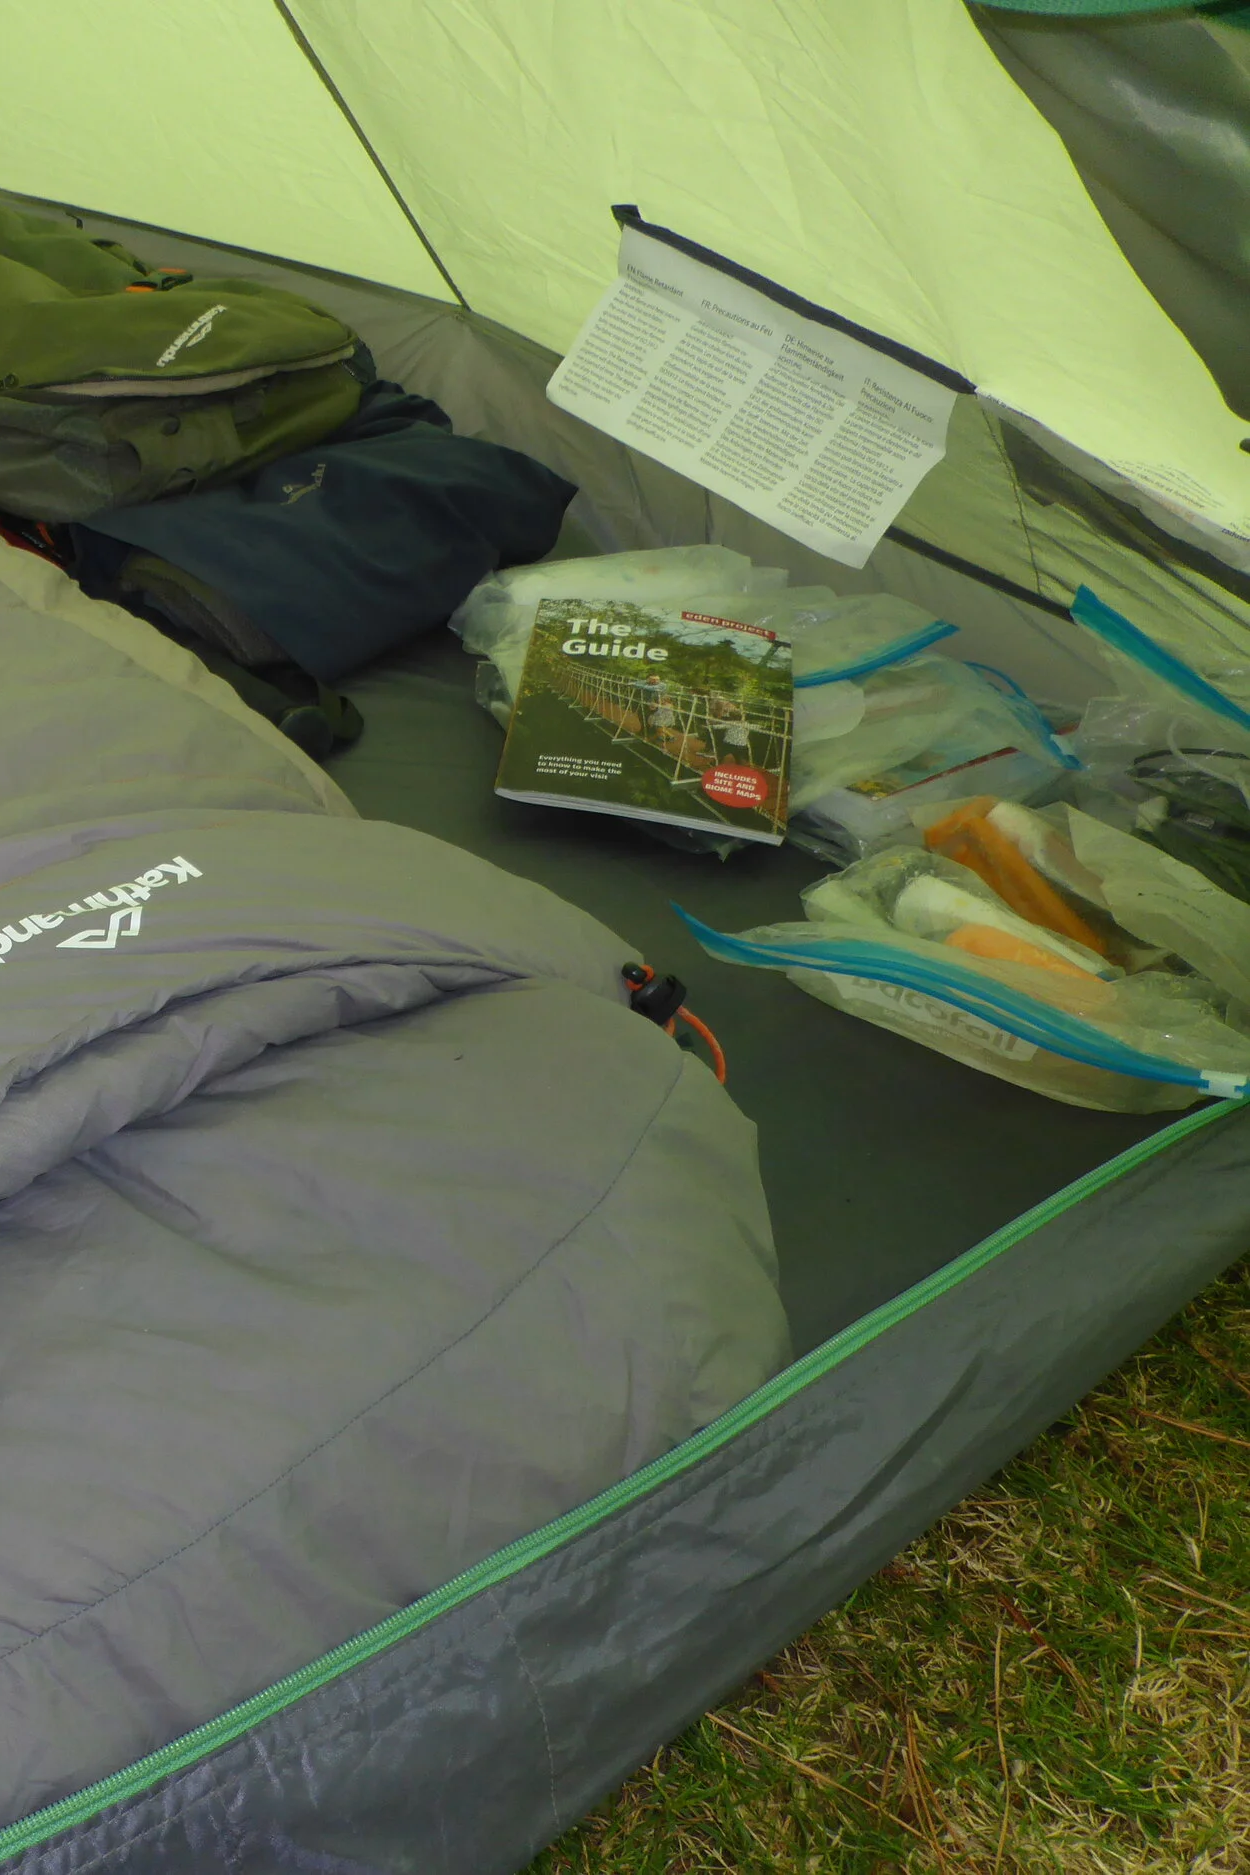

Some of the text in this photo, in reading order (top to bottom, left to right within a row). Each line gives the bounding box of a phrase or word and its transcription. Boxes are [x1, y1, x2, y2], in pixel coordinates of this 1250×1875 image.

[710, 303, 751, 327] Precautions
[749, 321, 760, 330] au
[868, 380, 906, 407] Resistenza
[566, 618, 632, 637] The
[685, 612, 769, 636] eden project
[561, 639, 669, 662] Guide
[538, 753, 582, 764] Everything
[713, 771, 757, 784] INCLUDES
[713, 777, 755, 791] SITE AND
[704, 783, 761, 800] BIOME MAPS
